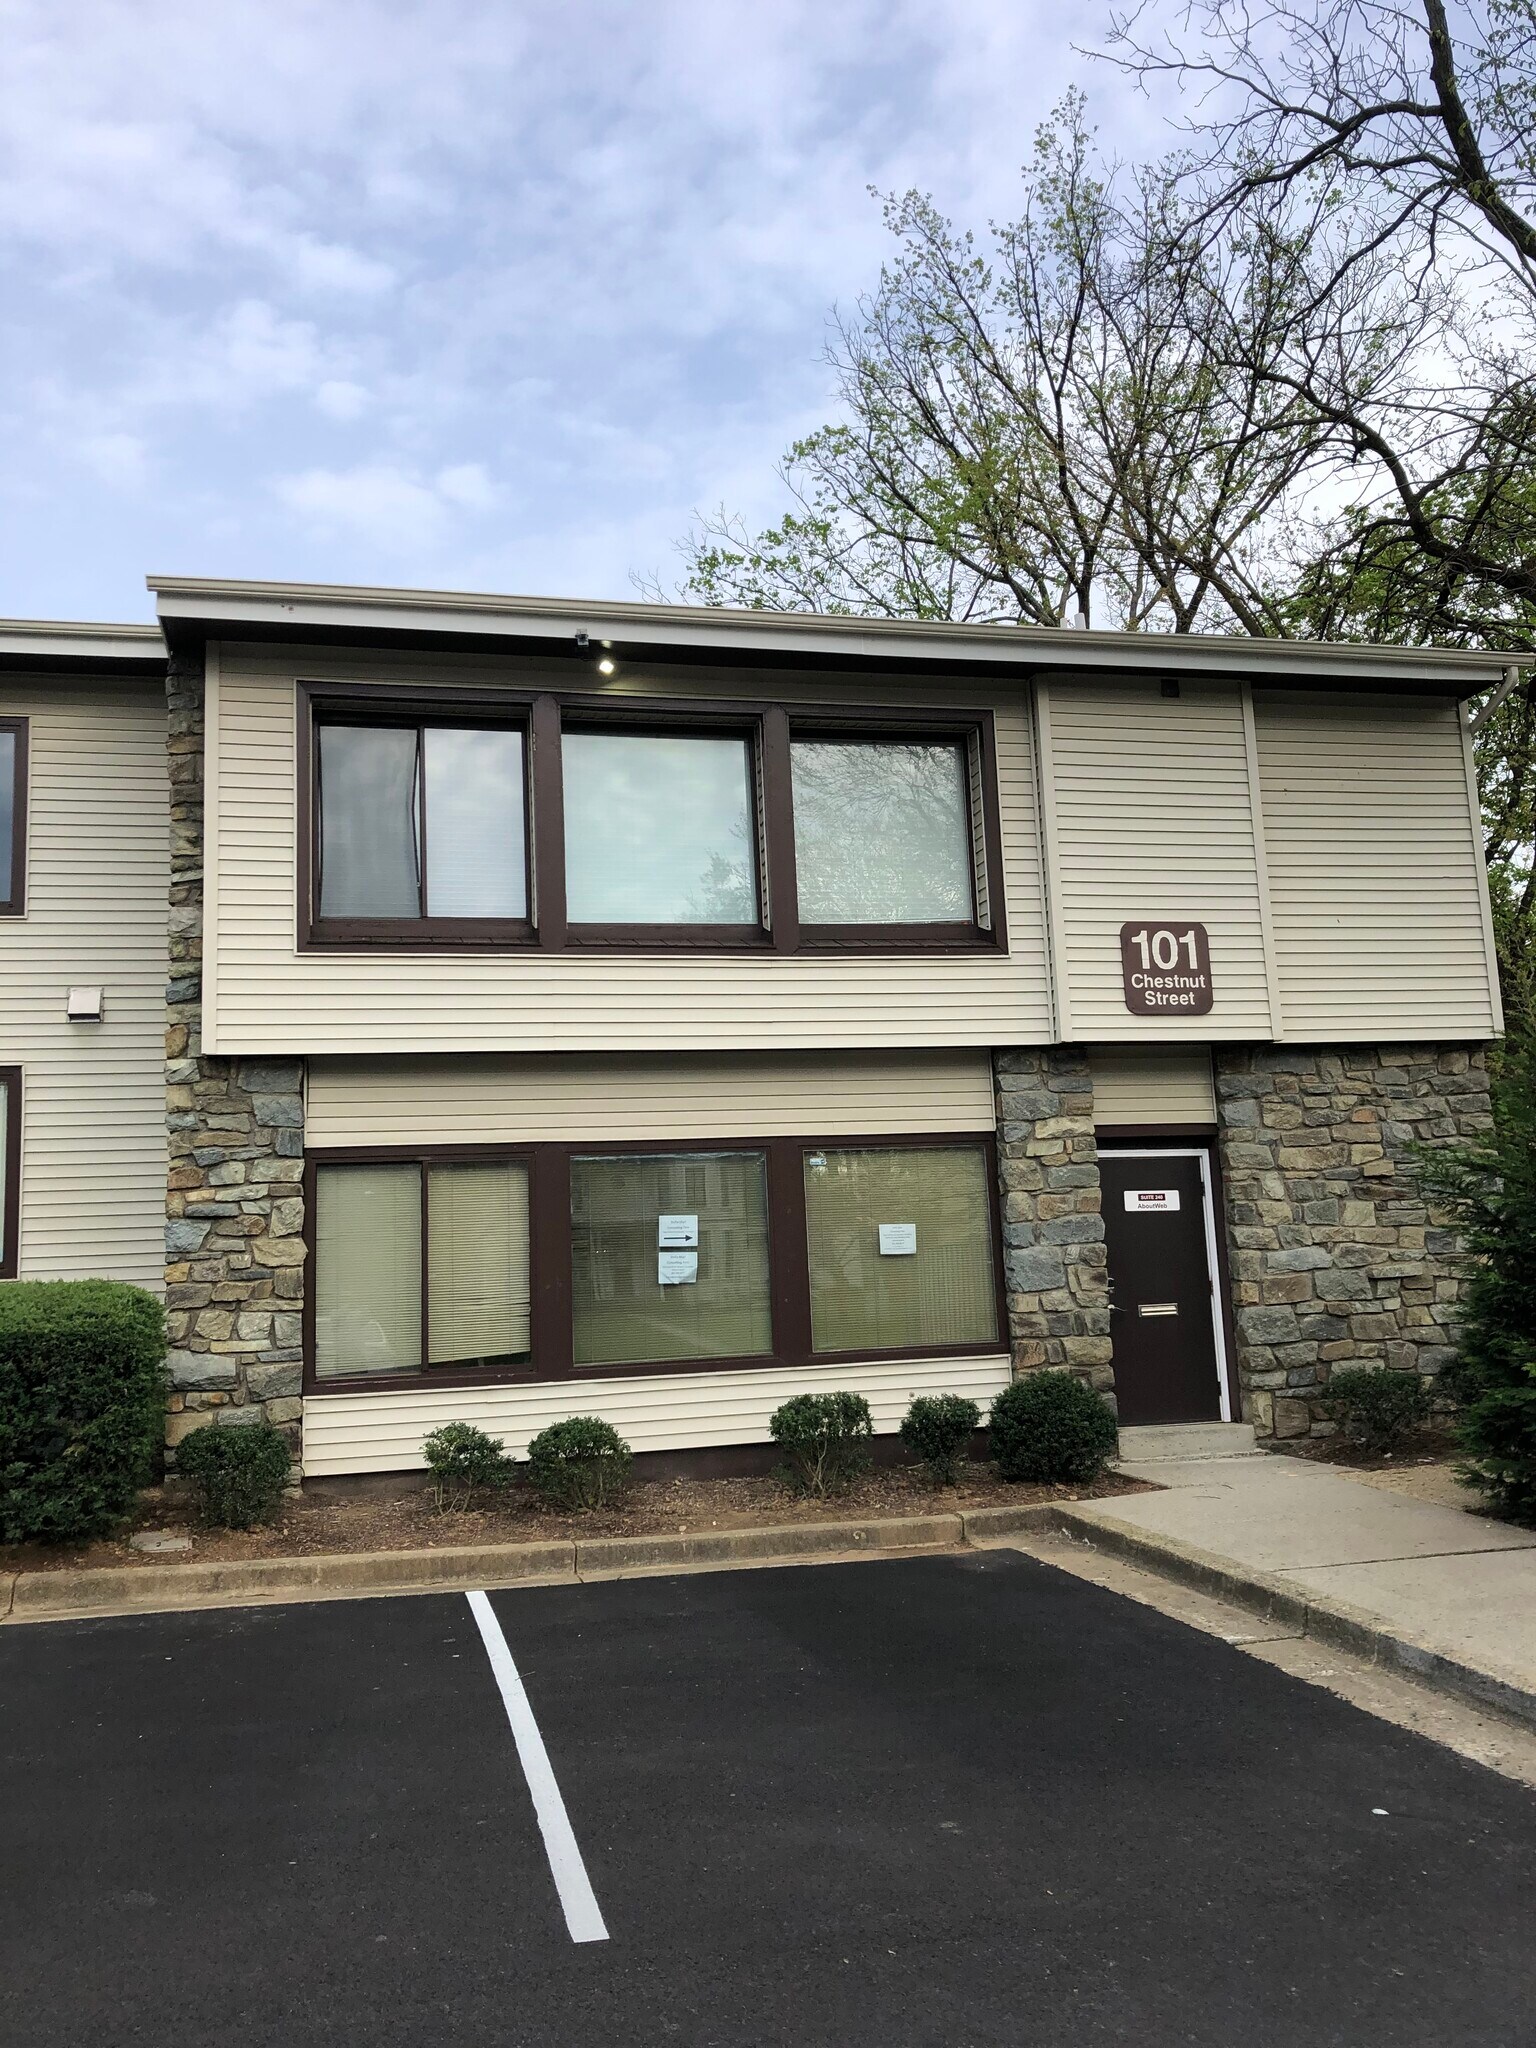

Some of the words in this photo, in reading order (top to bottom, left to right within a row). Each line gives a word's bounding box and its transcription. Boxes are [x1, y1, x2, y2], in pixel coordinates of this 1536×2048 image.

[1131, 930, 1198, 970] 101
[1131, 973, 1206, 988] Chestnut
[1144, 990, 1195, 1005] Street
